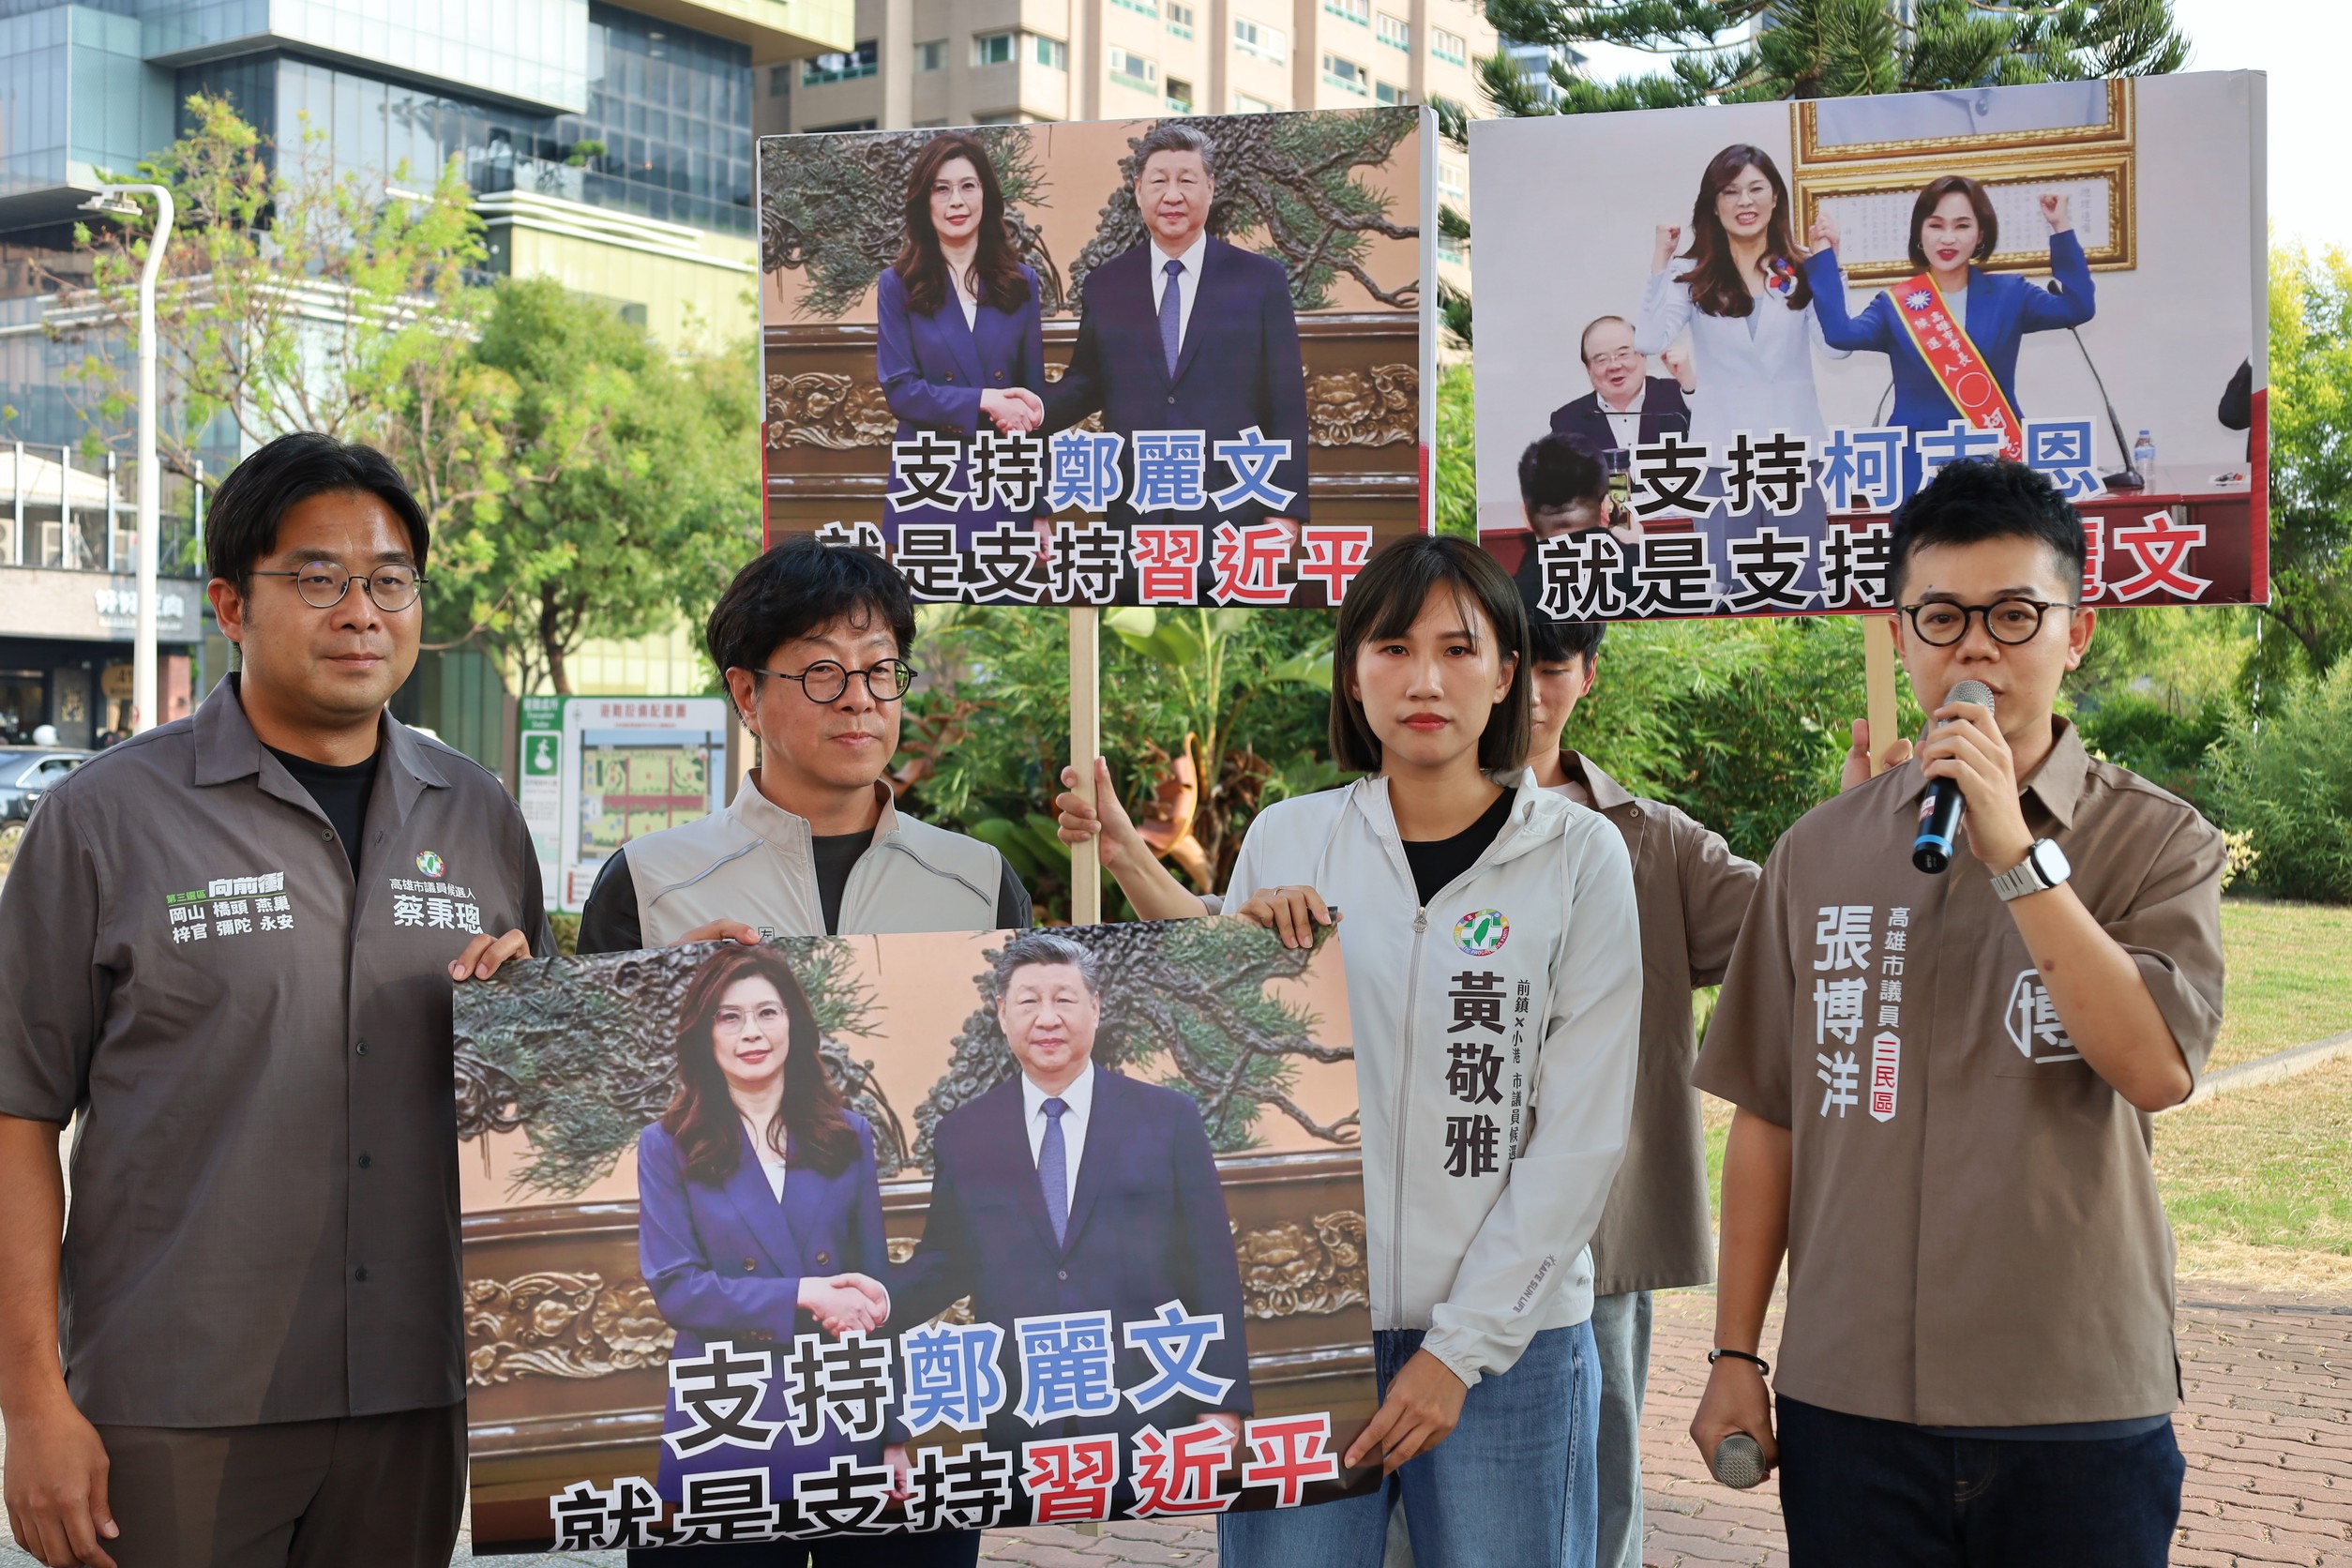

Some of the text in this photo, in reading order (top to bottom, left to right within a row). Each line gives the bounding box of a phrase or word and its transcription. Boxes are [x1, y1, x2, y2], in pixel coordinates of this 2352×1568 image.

[892, 429, 1294, 510] 支持鄭麗文
[1541, 513, 2210, 619] 就是支持文
[166, 871, 284, 904] 第三選區 向前衝
[169, 896, 291, 925] 岡山 橋頭 燕巢
[173, 913, 294, 943] 梓官 彌陀 永安
[389, 878, 475, 900] 高雄市議員候選人
[1877, 906, 1911, 1029] 高雄市議員
[1813, 905, 1874, 1118] 張博洋
[1443, 971, 1507, 1178] 黃敬雅
[1873, 1039, 1897, 1114] 三民區
[1508, 1072, 1523, 1172] 市議員候選
[1523, 1279, 1539, 1299] SUN
[1534, 1259, 1551, 1283] SAFE
[670, 1303, 1230, 1456] 支持鄭麗文
[552, 1414, 1338, 1551] 就是支持習近平
